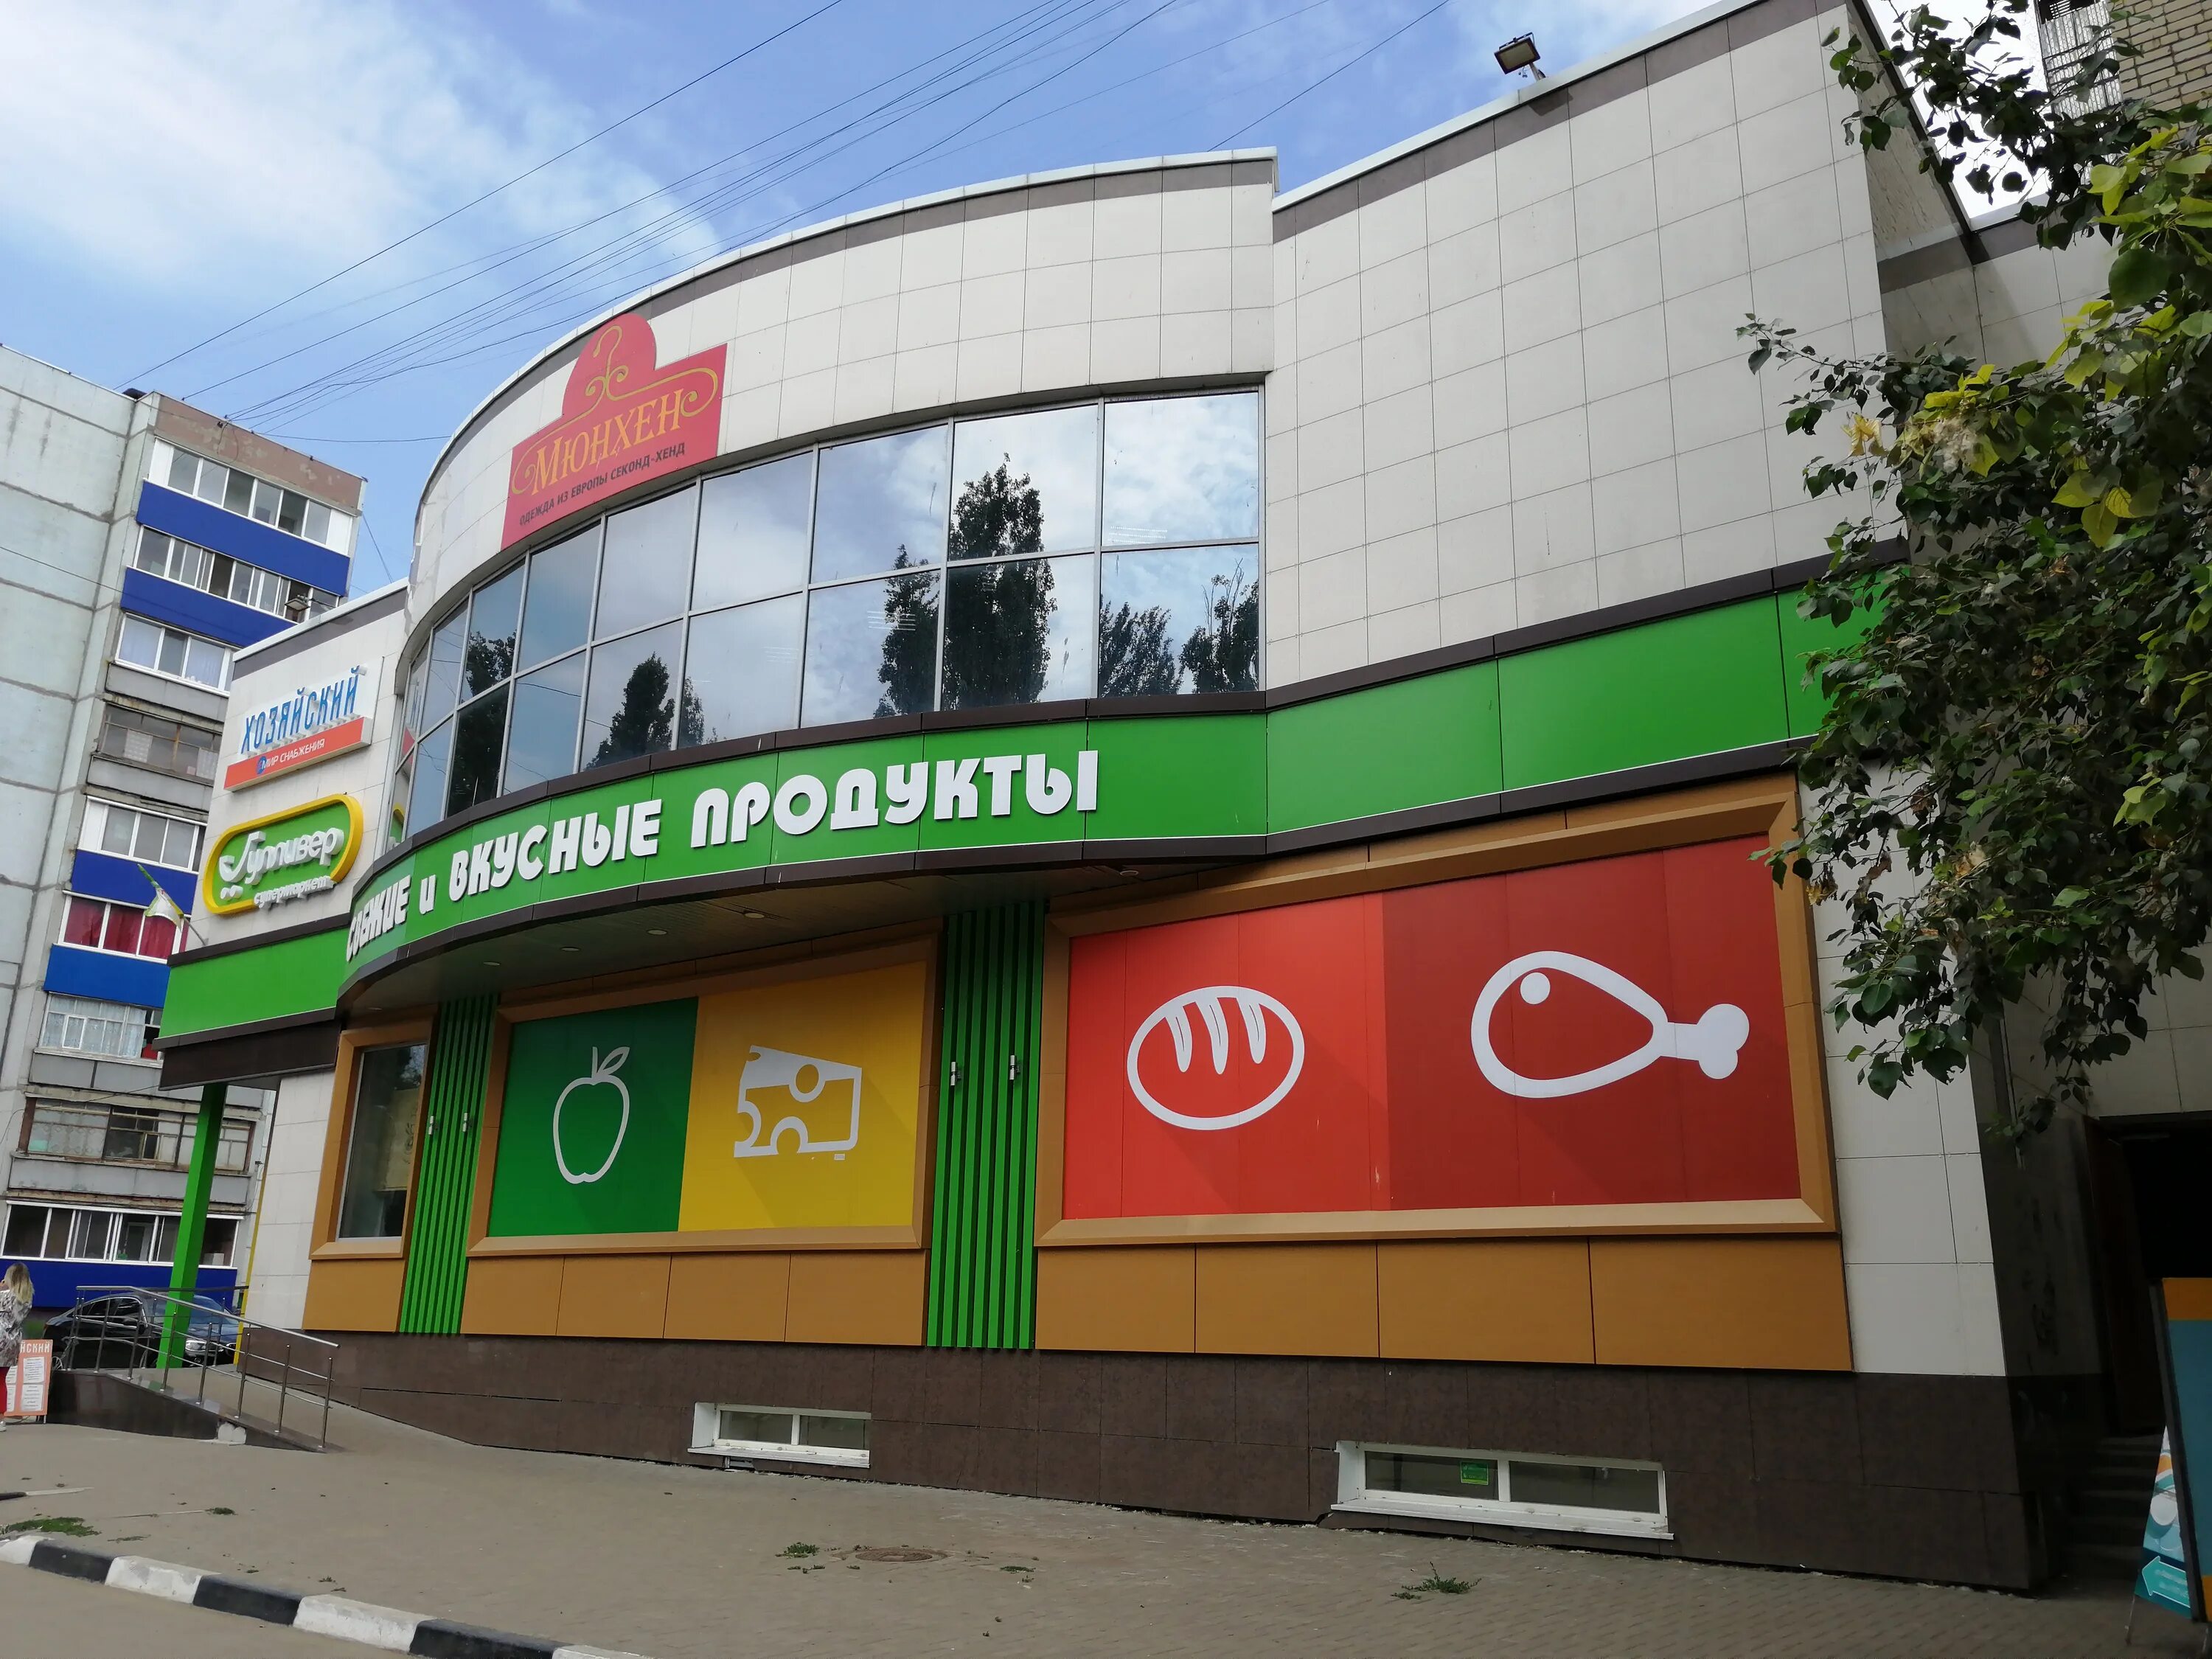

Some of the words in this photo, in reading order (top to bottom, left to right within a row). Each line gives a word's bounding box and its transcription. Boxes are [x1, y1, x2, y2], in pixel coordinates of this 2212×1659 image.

[531, 388, 684, 495] МЮНХЕН
[520, 498, 554, 526] ОДЕЖДА
[557, 490, 568, 506] ИЗ
[571, 473, 608, 498] ЕВРОПЫ
[611, 442, 686, 481] СЕКОНД-ХЕНД
[240, 665, 361, 754] ХОЗЯЙСКИЙ
[261, 756, 279, 769] МИР
[280, 738, 325, 763] СНАБЖЕНИЯ
[219, 827, 345, 885] Гулливер
[448, 799, 662, 902] ВКУСНЫЕ
[690, 750, 1099, 849] ПРОДУКТЫ
[254, 875, 335, 909] супермаркет
[20, 1340, 51, 1353] ЙСКИЙ
